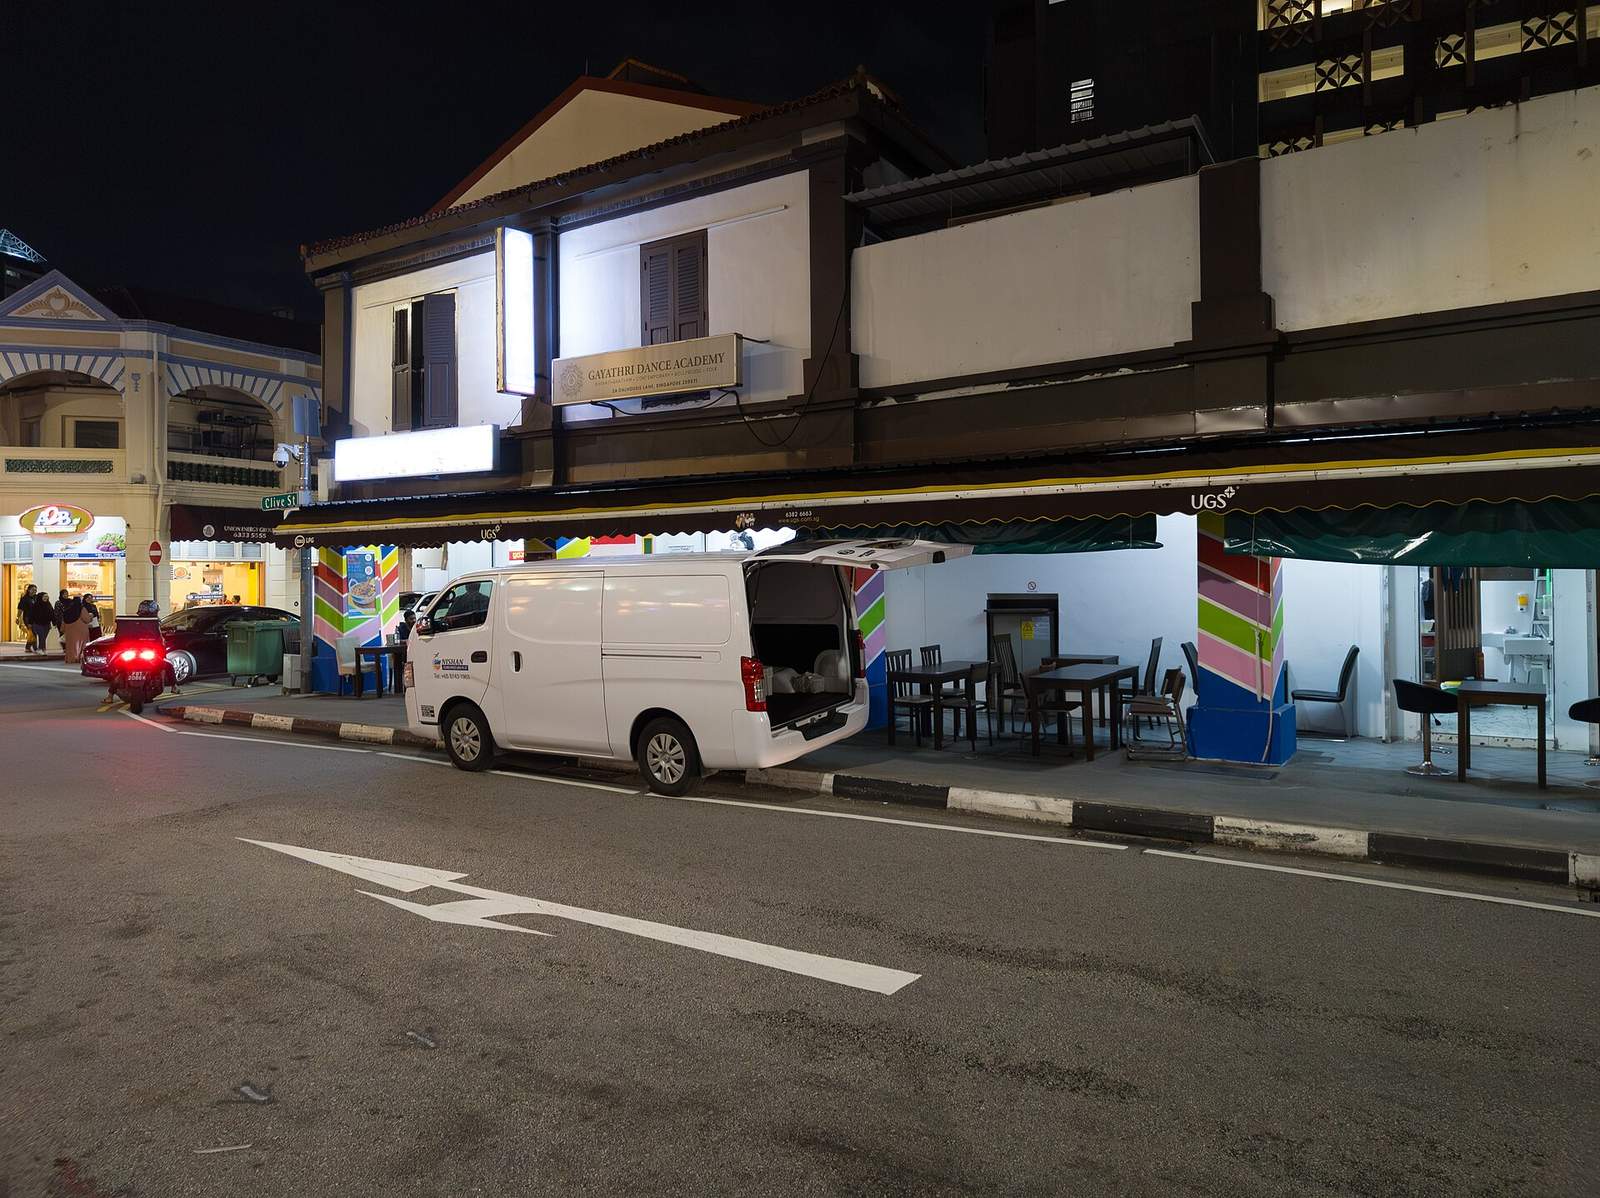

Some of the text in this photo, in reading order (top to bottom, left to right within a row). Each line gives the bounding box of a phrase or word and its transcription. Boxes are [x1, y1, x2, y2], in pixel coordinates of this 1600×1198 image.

[588, 365, 635, 380] GAYATHRI
[637, 360, 672, 374] DANCE
[673, 352, 726, 369] ACADEMY
[265, 496, 296, 509] Clive St
[1191, 494, 1227, 509] UGS
[481, 529, 497, 540] UGS
